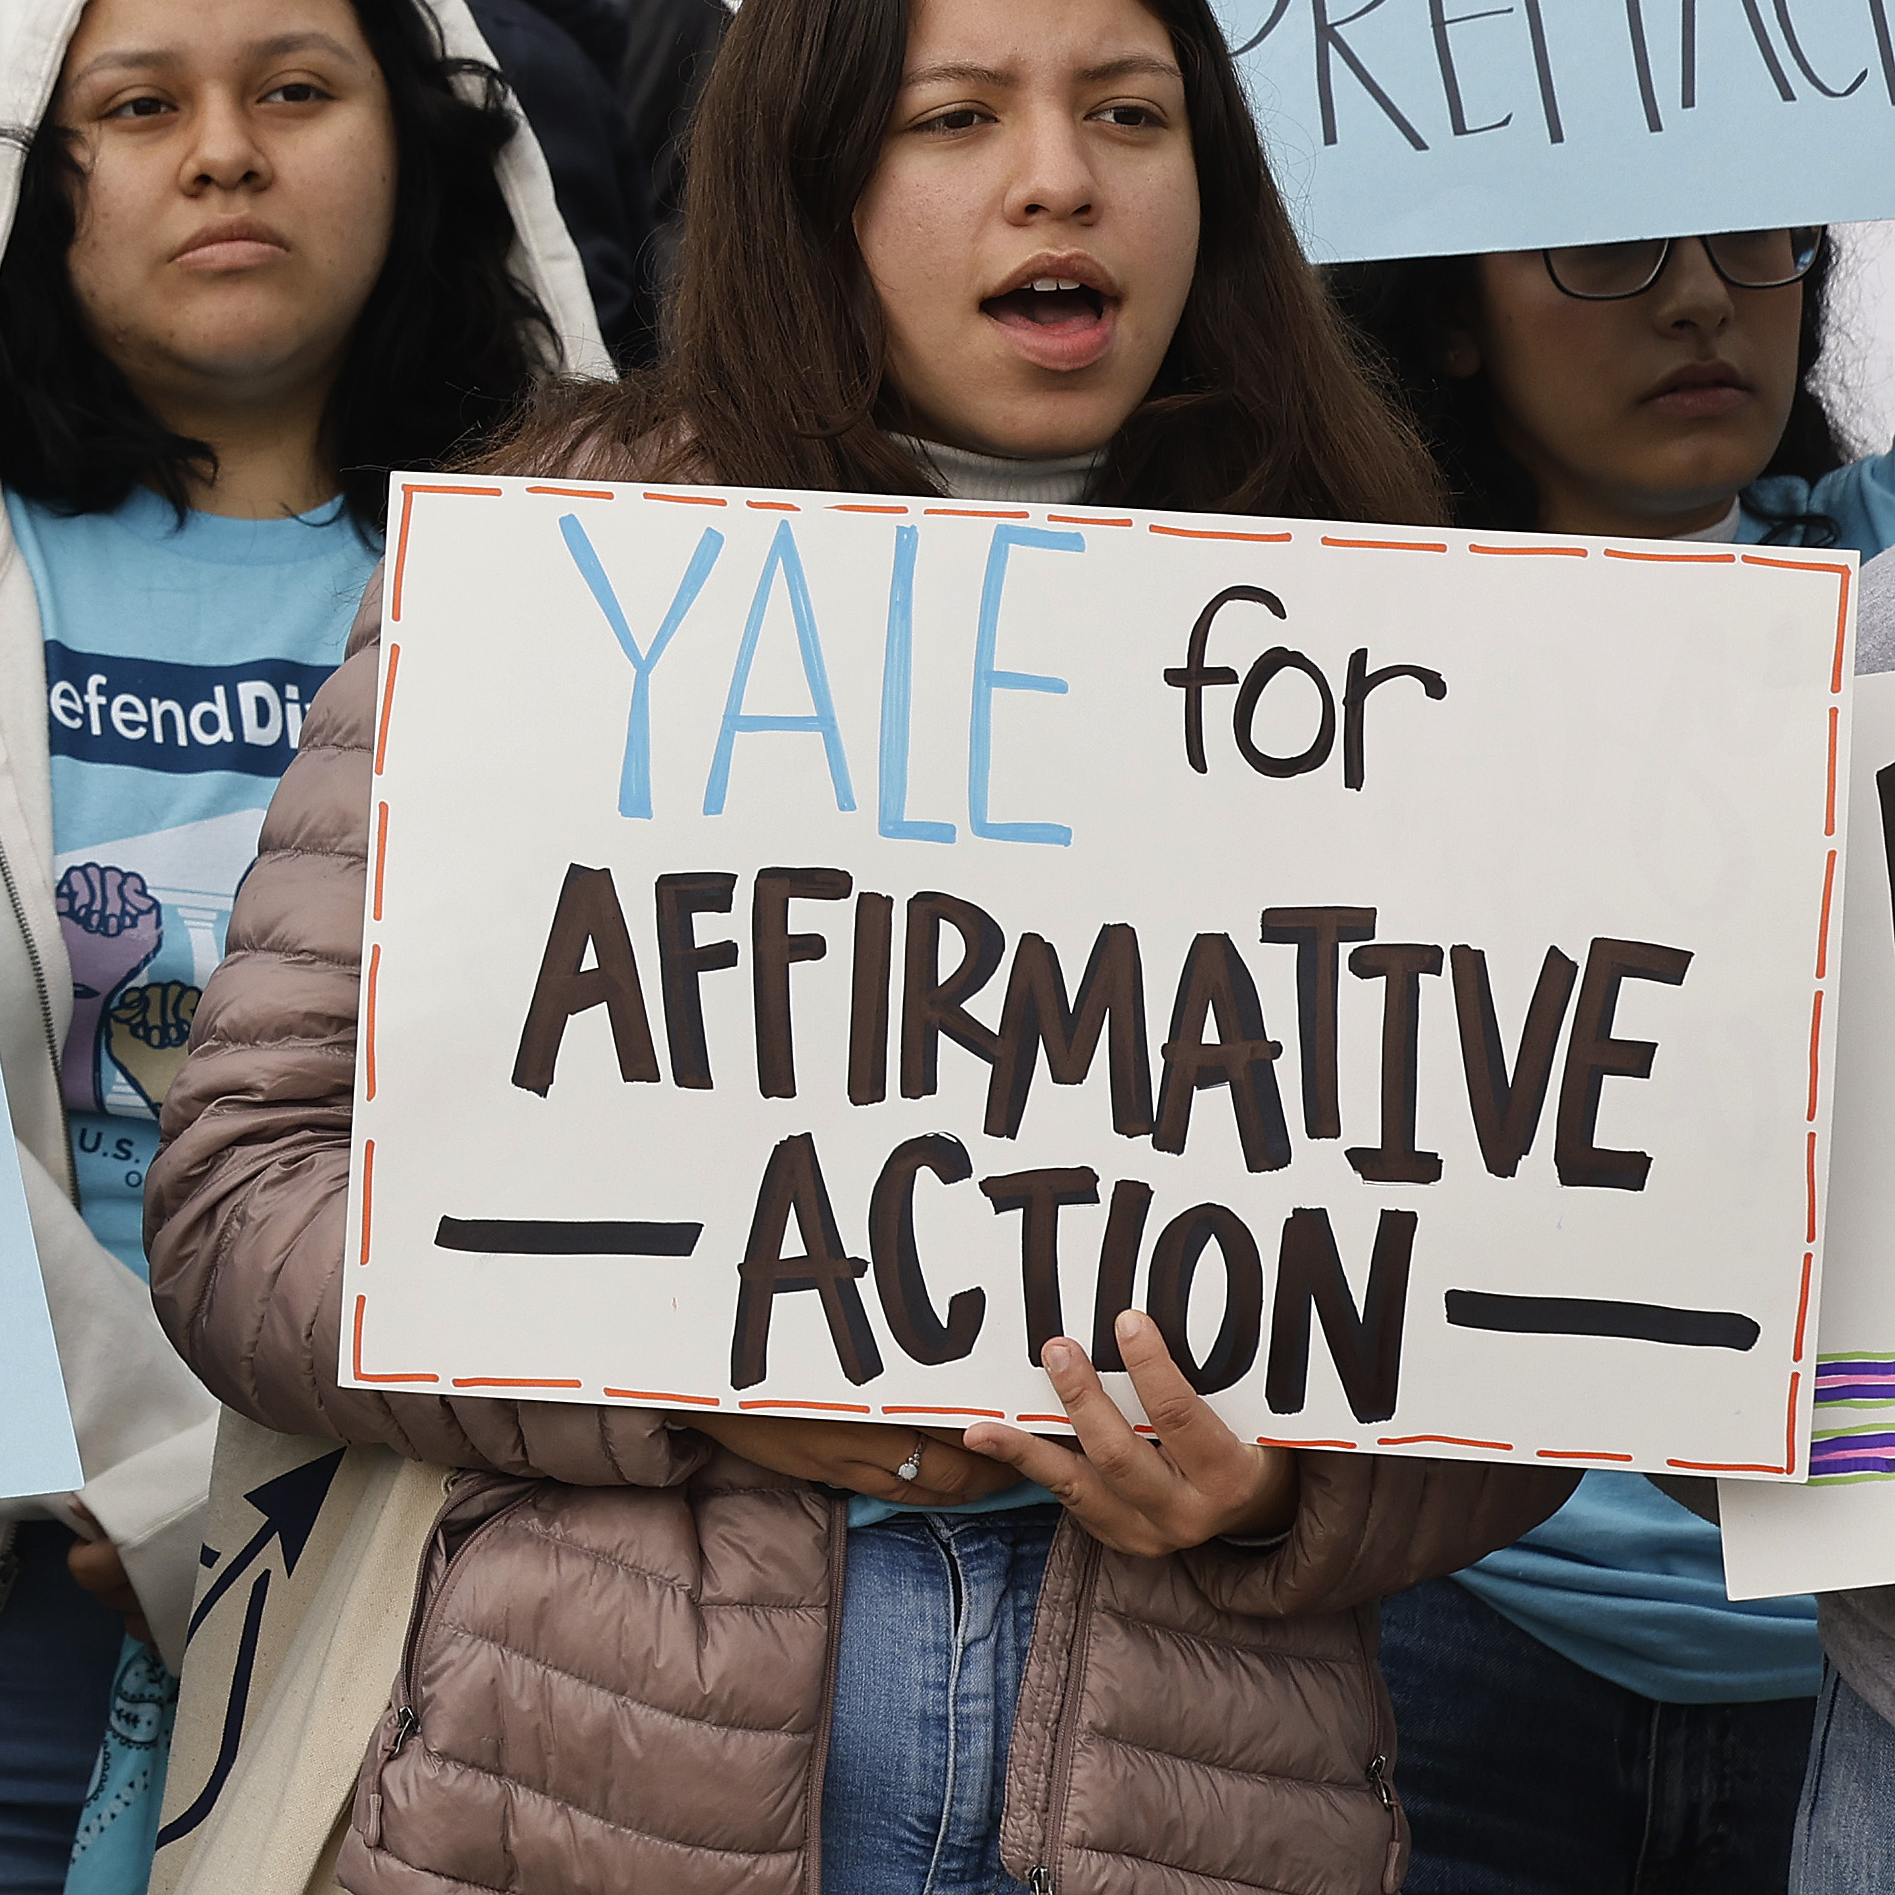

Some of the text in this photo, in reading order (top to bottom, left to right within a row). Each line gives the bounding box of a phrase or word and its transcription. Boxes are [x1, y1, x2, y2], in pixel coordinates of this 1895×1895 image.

[49, 672, 313, 750] efendDi
[559, 512, 1086, 847] YALE
[1163, 584, 1448, 792] for
[78, 1126, 141, 1165] U.S.
[510, 862, 1695, 1192] AFFIRMATIVE
[730, 1132, 1419, 1425] ACTION
